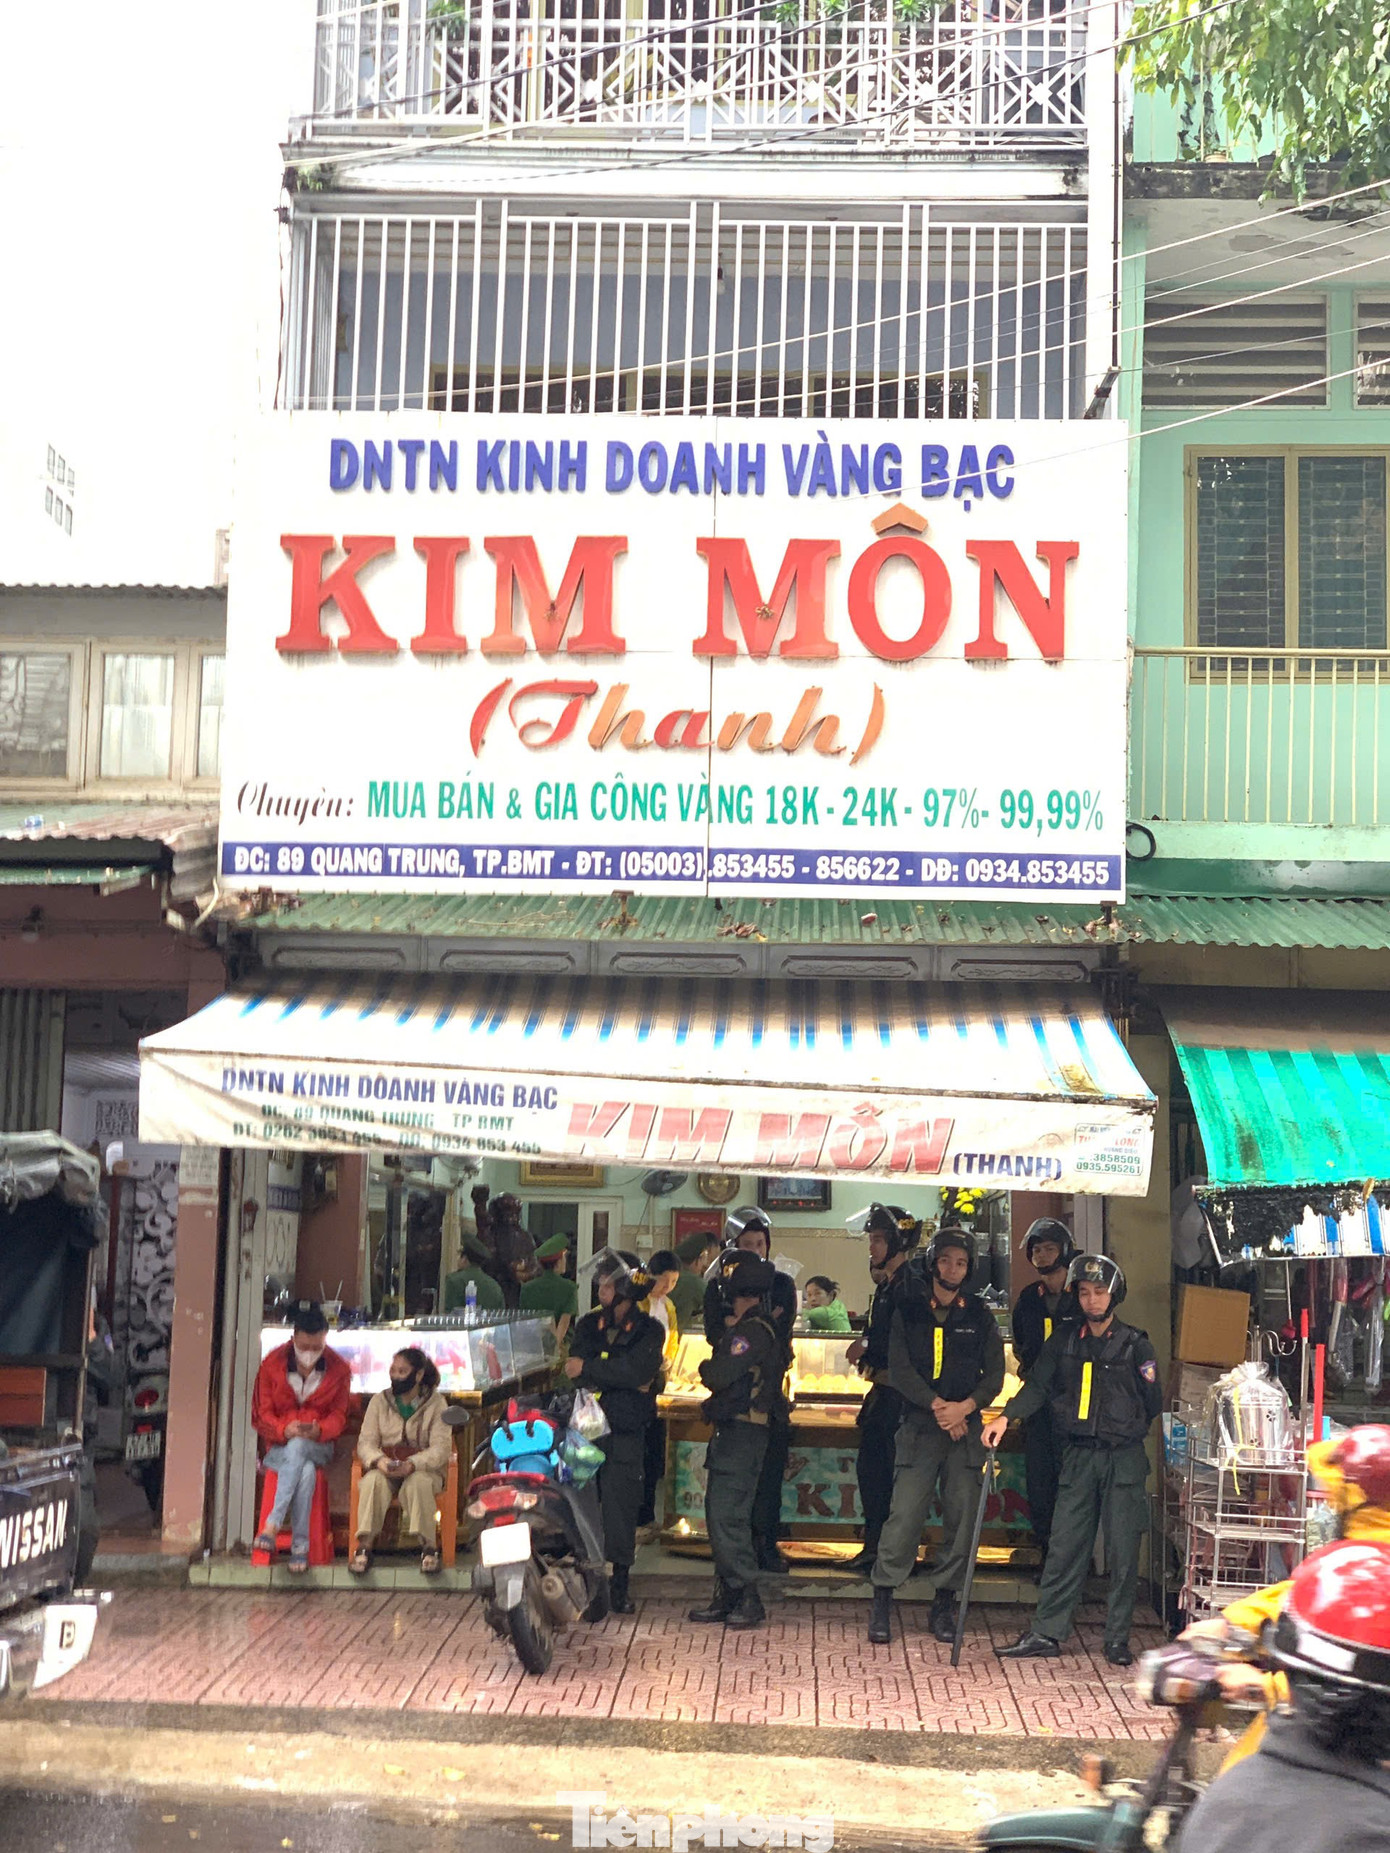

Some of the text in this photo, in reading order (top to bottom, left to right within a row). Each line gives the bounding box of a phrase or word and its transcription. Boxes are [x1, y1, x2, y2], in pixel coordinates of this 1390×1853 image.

[330, 430, 1014, 512] DNTN KINH DOANH VÀNG BẠC
[275, 502, 1079, 661] KIM MÔN
[469, 677, 886, 766] (Thanh)
[367, 780, 426, 818] MUA
[438, 770, 494, 820] BÁN
[506, 788, 522, 820] &
[535, 781, 578, 821] GIA
[590, 772, 667, 822] CÔNG
[677, 772, 753, 824] VÀNG
[766, 785, 819, 825] 18K
[842, 786, 898, 827] 24K
[1000, 789, 1104, 838] 99,99%
[234, 846, 270, 873] ĐC:
[277, 846, 305, 873] 89
[310, 847, 383, 876] QUANG
[388, 847, 466, 877] TRUNG,
[473, 849, 555, 876] TP.BMT
[576, 851, 612, 876] ĐT:
[816, 855, 900, 881] 856622
[921, 858, 959, 882] DĐ:
[965, 858, 1110, 885] 0934.853455
[221, 1067, 285, 1094] DNTN
[293, 1070, 350, 1097] KINH
[443, 1077, 505, 1107] VÀNG
[512, 1083, 558, 1115] BẠC
[568, 1101, 955, 1175] KIM MÔN
[953, 1153, 1063, 1181] (THANH)
[1076, 1162, 1141, 1174] 0935.595261
[0, 1499, 67, 1568] NISSAN
